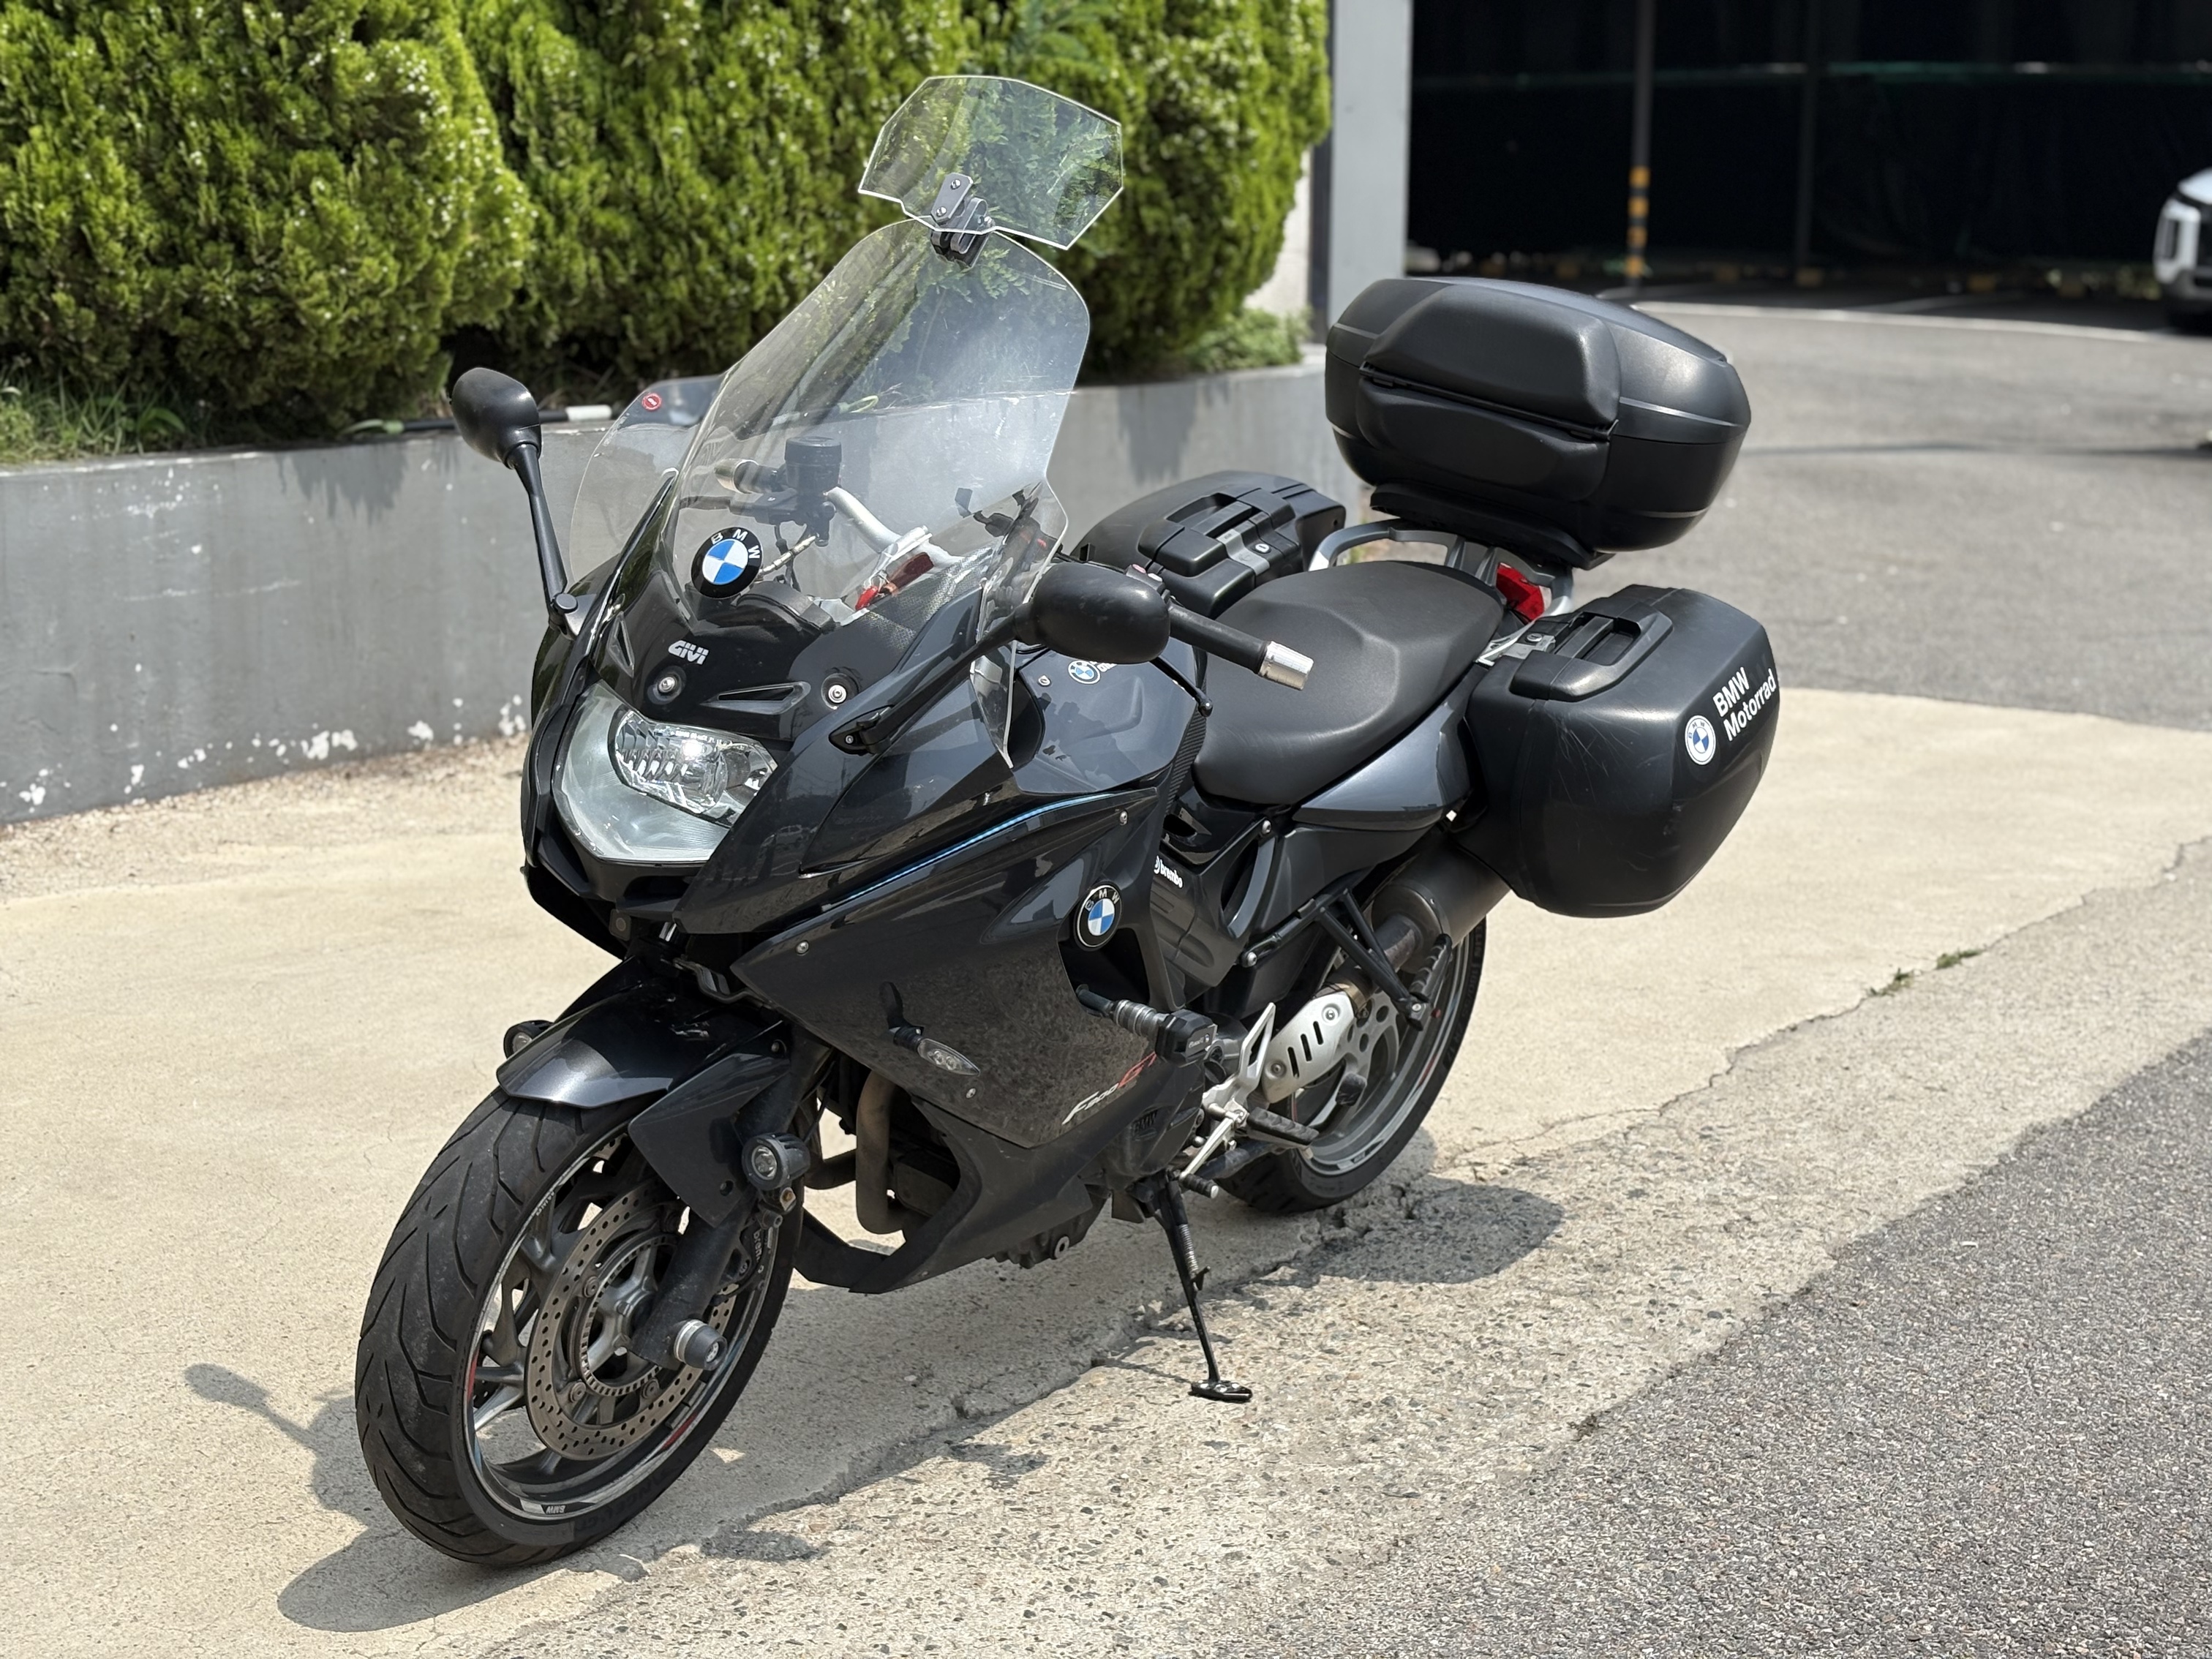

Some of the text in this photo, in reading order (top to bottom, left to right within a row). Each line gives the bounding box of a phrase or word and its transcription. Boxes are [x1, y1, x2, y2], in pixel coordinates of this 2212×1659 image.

[711, 529, 761, 559] BMW
[669, 640, 709, 665] GIVI
[1713, 666, 1750, 717] BMW
[1723, 668, 1777, 742] Motorrad
[1085, 889, 1120, 911] BMW
